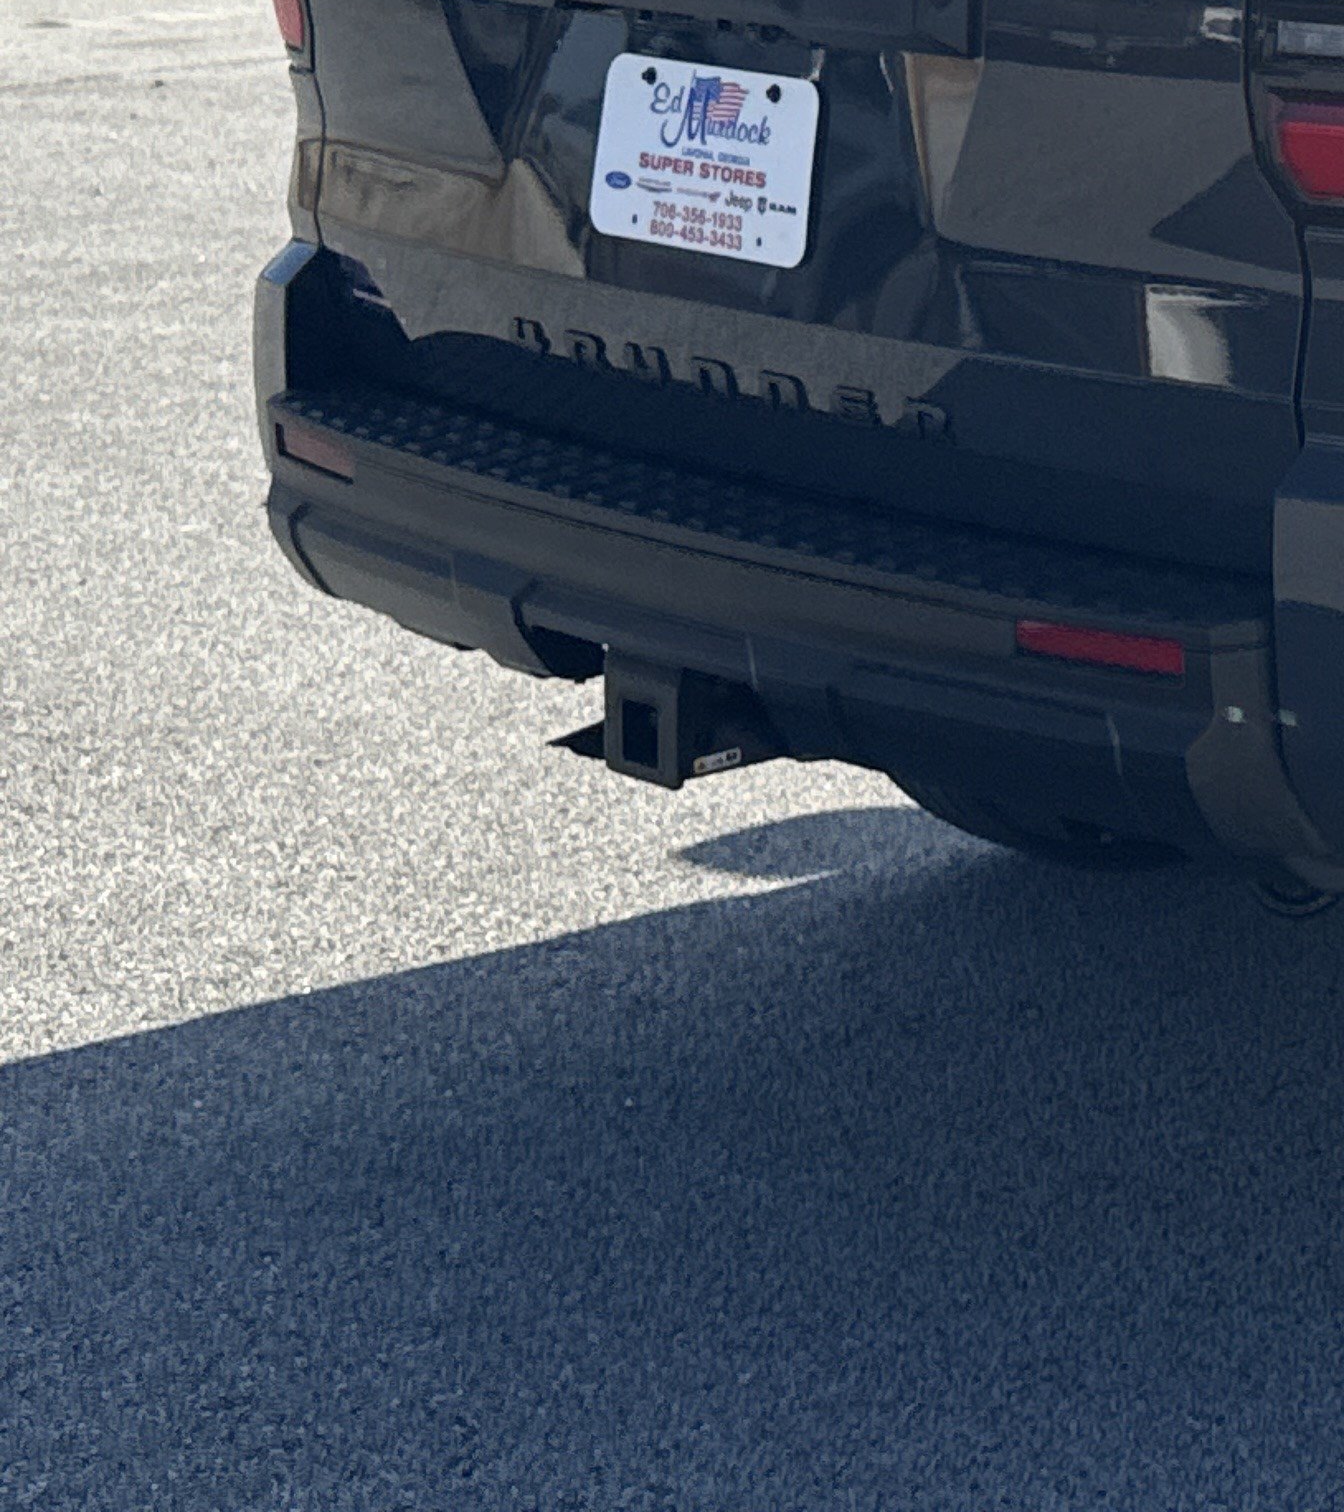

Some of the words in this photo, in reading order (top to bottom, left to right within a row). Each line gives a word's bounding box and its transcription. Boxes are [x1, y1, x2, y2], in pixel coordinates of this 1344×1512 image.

[650, 82, 685, 114] Ed
[661, 70, 771, 148] Murdock
[639, 152, 694, 176] SUPER
[699, 162, 767, 189] STORES
[511, 316, 956, 443] 4RUNNER
